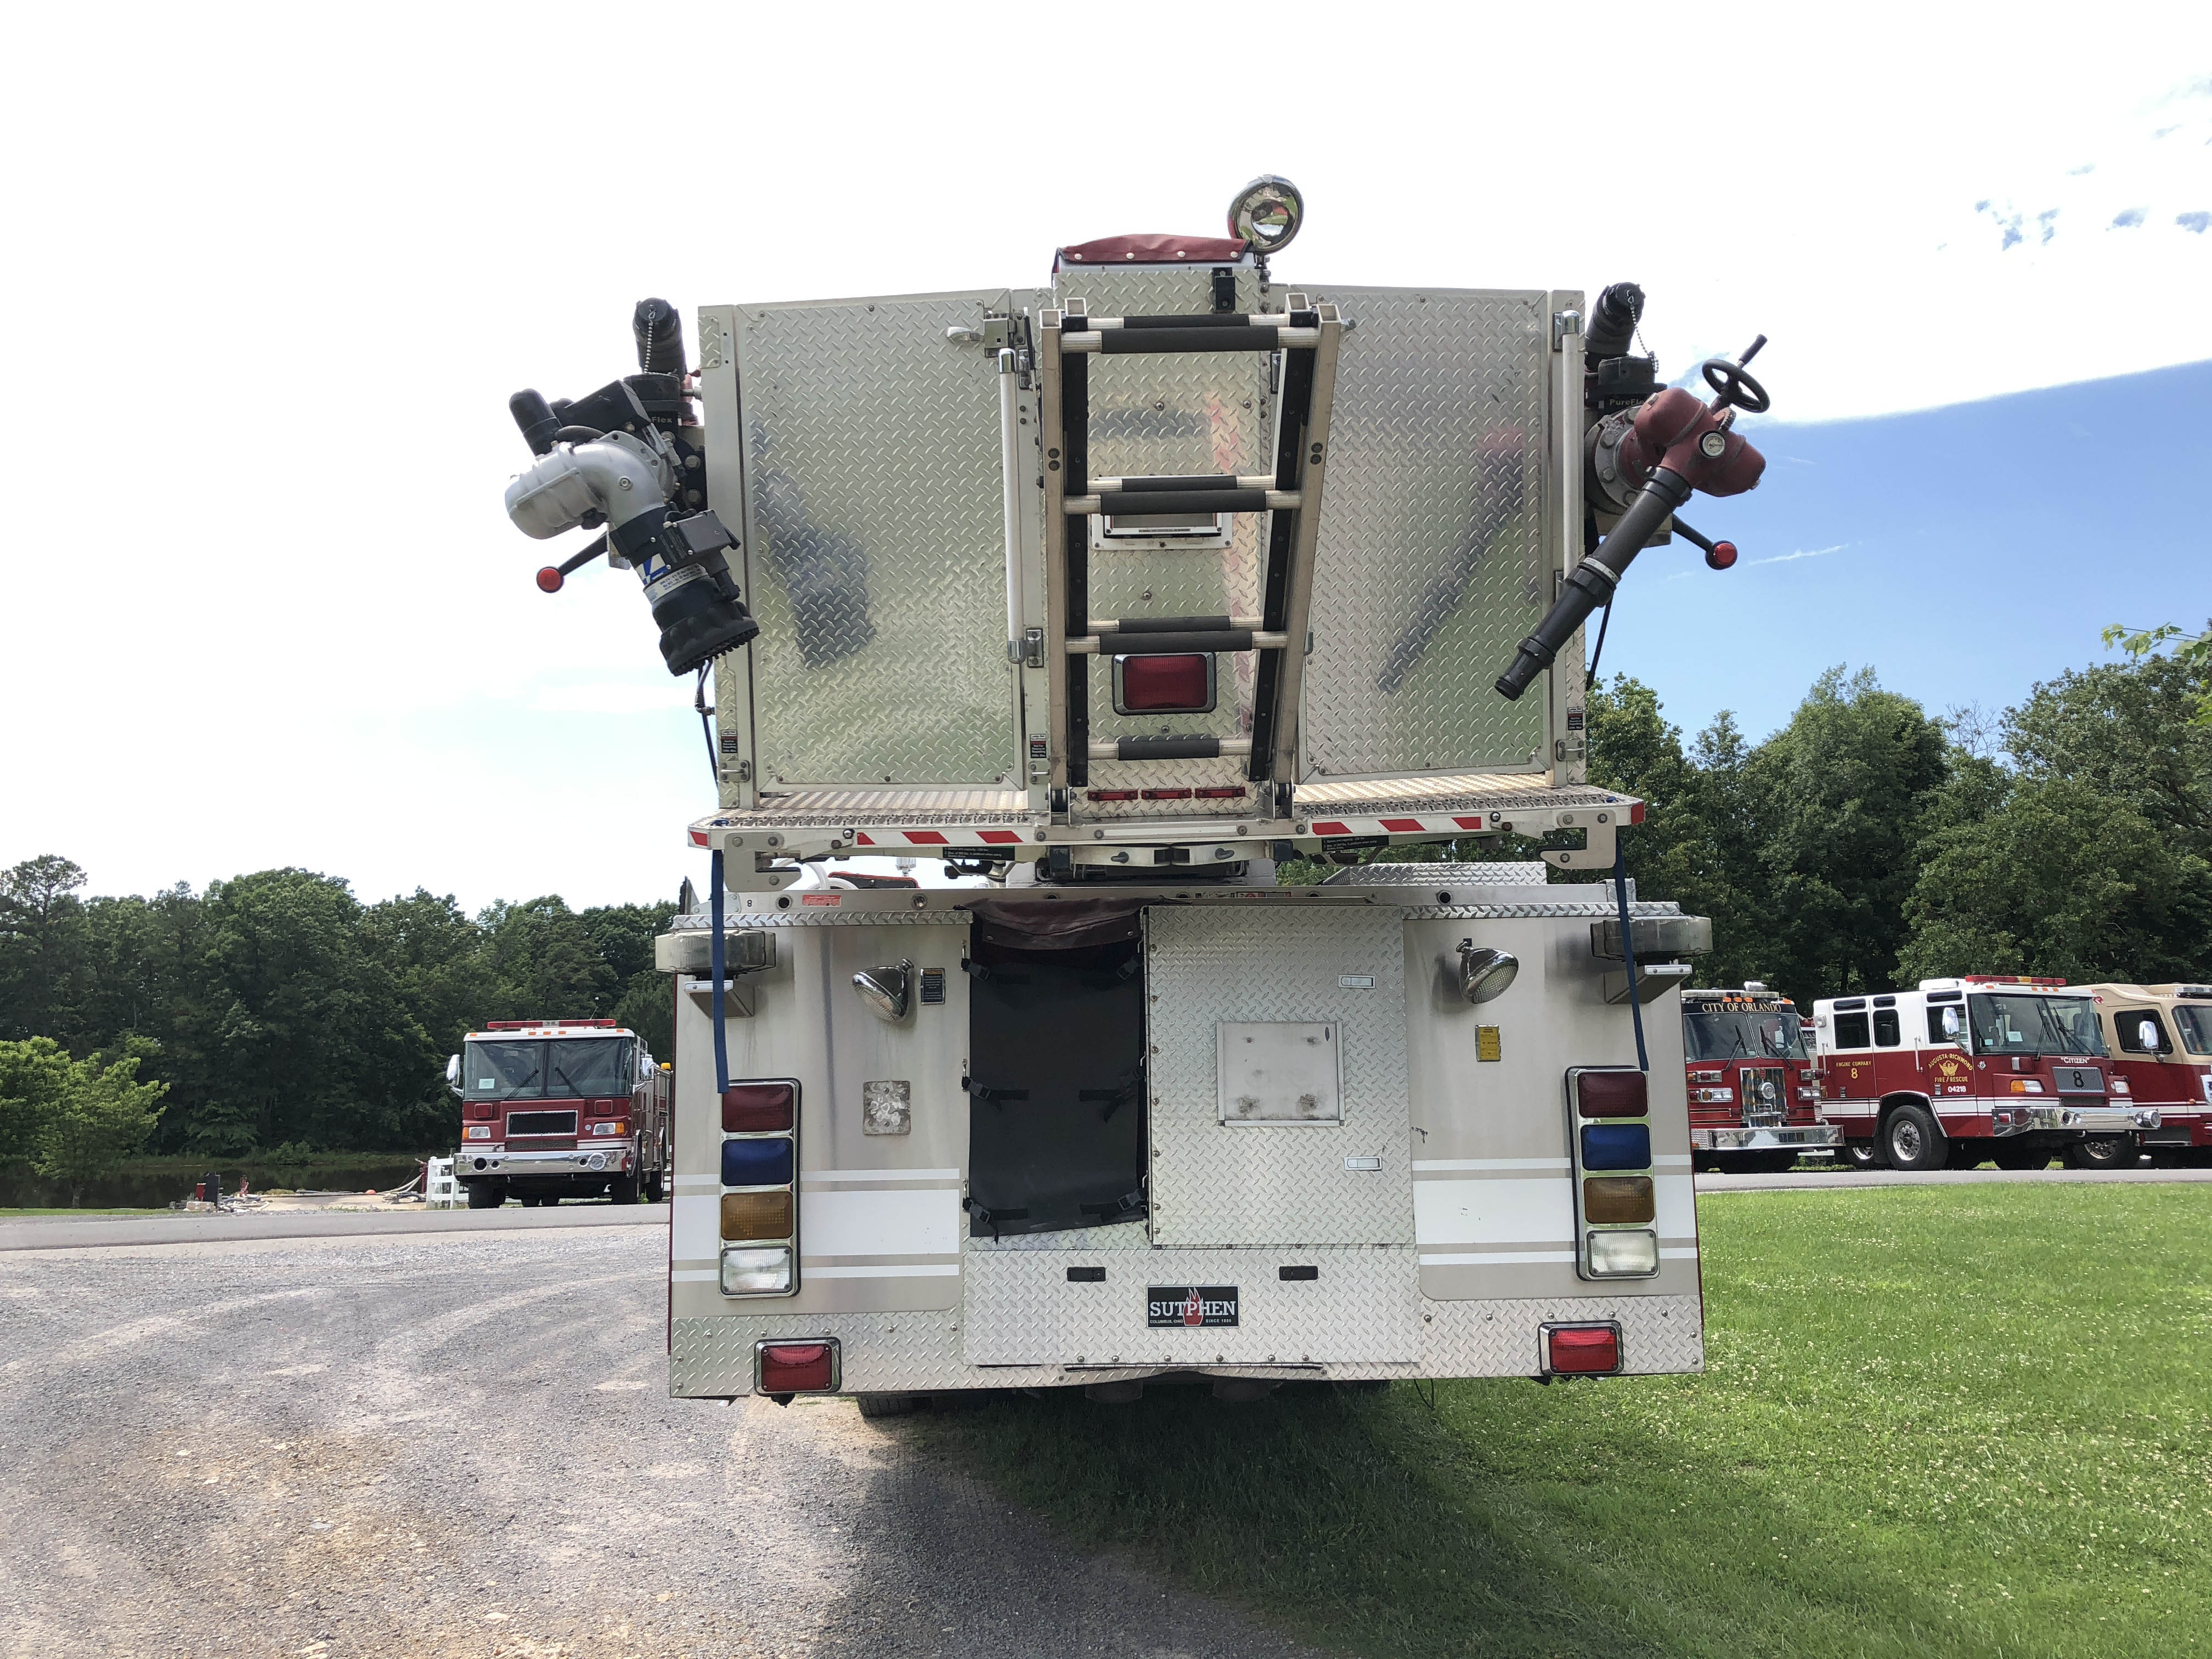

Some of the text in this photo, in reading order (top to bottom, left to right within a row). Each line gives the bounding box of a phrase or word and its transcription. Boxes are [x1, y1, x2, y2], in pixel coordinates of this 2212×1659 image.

[1702, 1002, 1781, 1012] CITY OF ORLANDO
[1851, 1068, 1858, 1079] 8
[2073, 1070, 2084, 1088] 8
[1149, 1301, 1236, 1317] SUTPHEN
